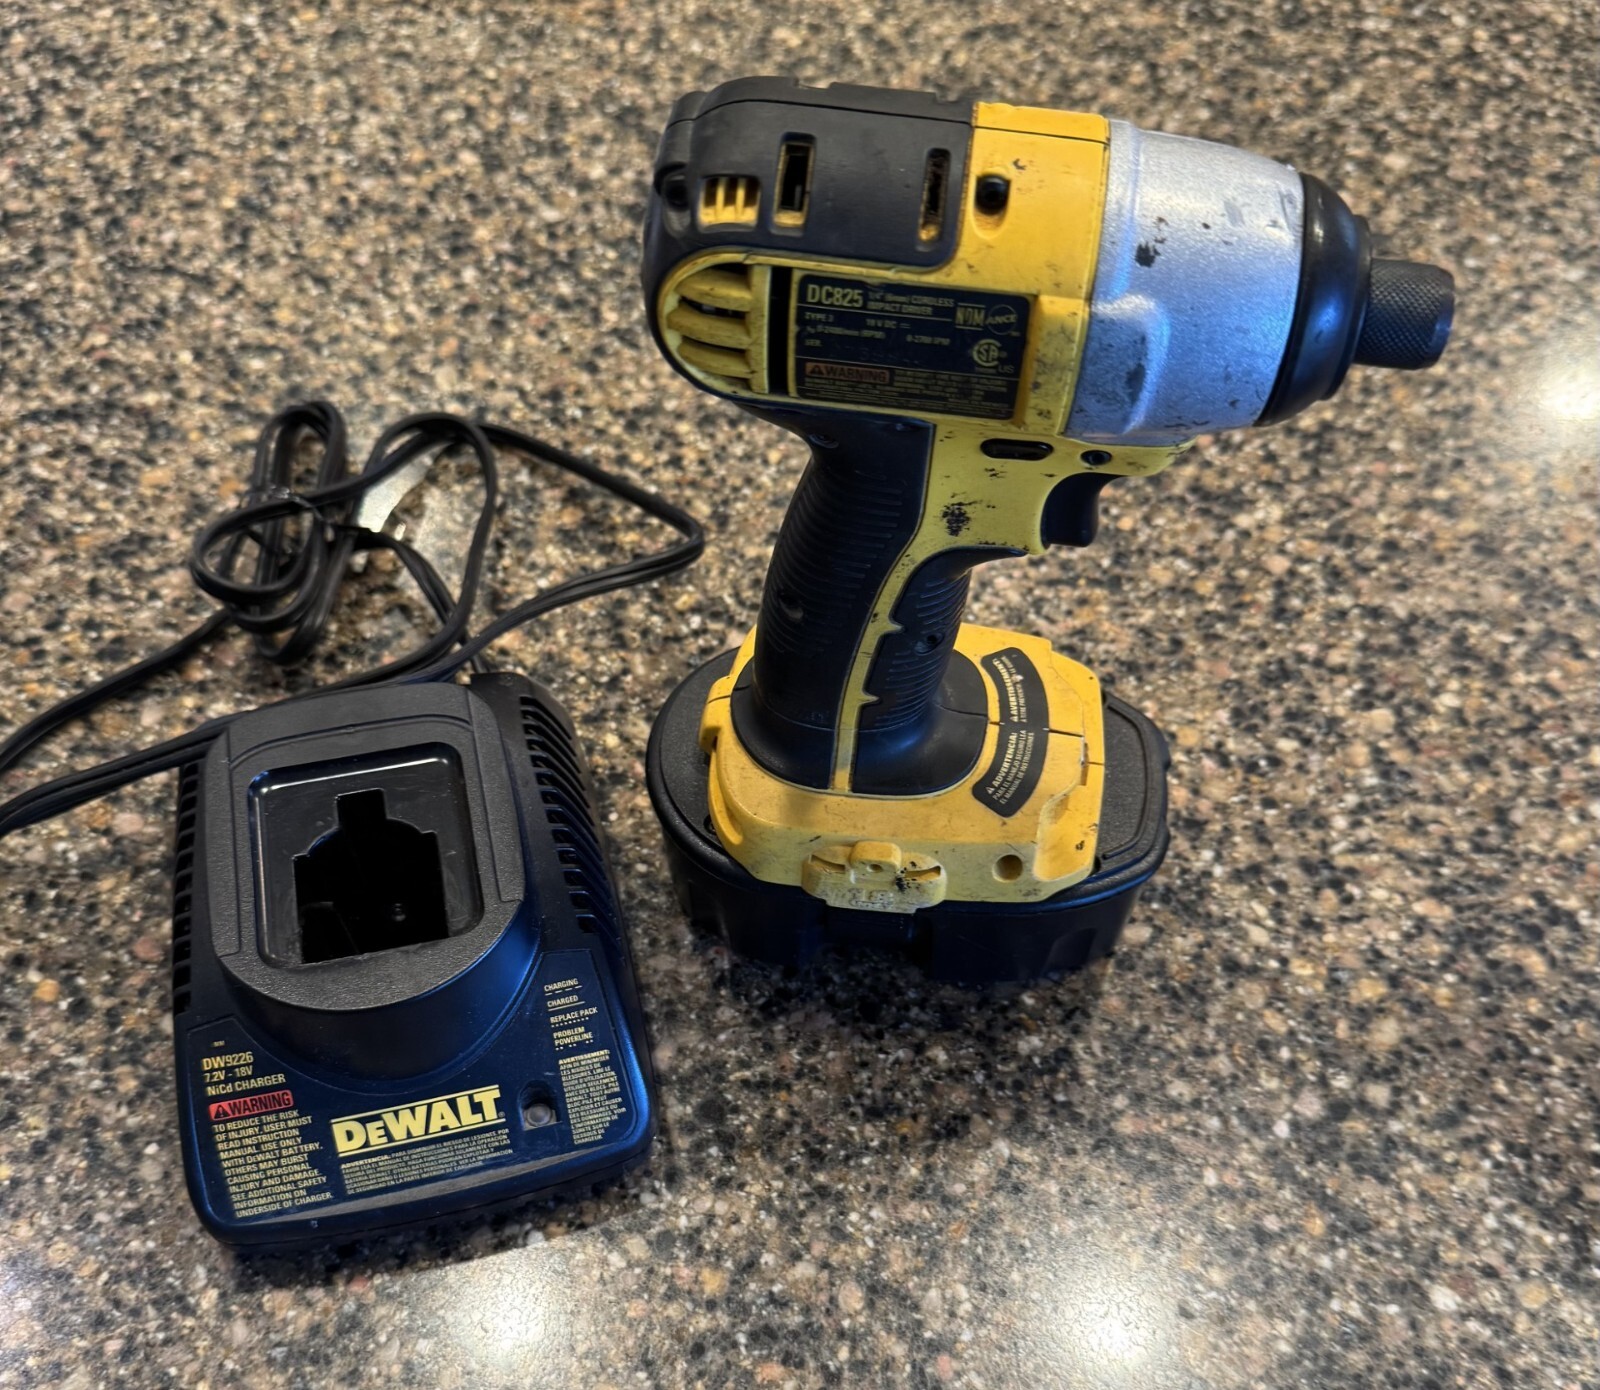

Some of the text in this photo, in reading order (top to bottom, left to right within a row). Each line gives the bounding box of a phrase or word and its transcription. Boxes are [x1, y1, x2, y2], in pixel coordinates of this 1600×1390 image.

[807, 284, 863, 307] DC825
[956, 307, 985, 327] NOM
[986, 313, 1017, 325] ANCE
[827, 367, 887, 382] WARNING
[544, 978, 578, 992] CHARGING
[547, 995, 578, 1007] CHARGED
[550, 1007, 598, 1024] REPLACE PACK
[553, 1027, 585, 1039] PROBLEM
[555, 1032, 593, 1045] POWERLINE
[202, 1051, 254, 1070] DW9226
[203, 1069, 227, 1083] 7.2V
[234, 1065, 254, 1077] 18V
[206, 1073, 286, 1096] NiCd CHARGER
[228, 1091, 291, 1116] WARNING
[213, 1109, 299, 1132] TO REDUCE THE RISK
[215, 1132, 227, 1141] OF
[263, 1121, 286, 1132] USER
[286, 1115, 313, 1127] MUST
[217, 1127, 299, 1151] READ INSTRUCTION
[260, 1141, 278, 1151] USE
[278, 1136, 302, 1147] ONLY
[221, 1156, 245, 1168] WITH
[281, 1141, 323, 1156] BATTERY.
[224, 1153, 309, 1177] OTHERS MAY BURST
[226, 1161, 312, 1185] CAUSING PERSONAL
[228, 1181, 260, 1194] INJURY
[261, 1176, 281, 1187] AND
[230, 1175, 328, 1202] SEE ADDITIONAL SAFETY
[233, 1188, 307, 1210] INFORMATION ON
[235, 1202, 282, 1218] UNDERSIDE
[283, 1200, 293, 1208] OF
